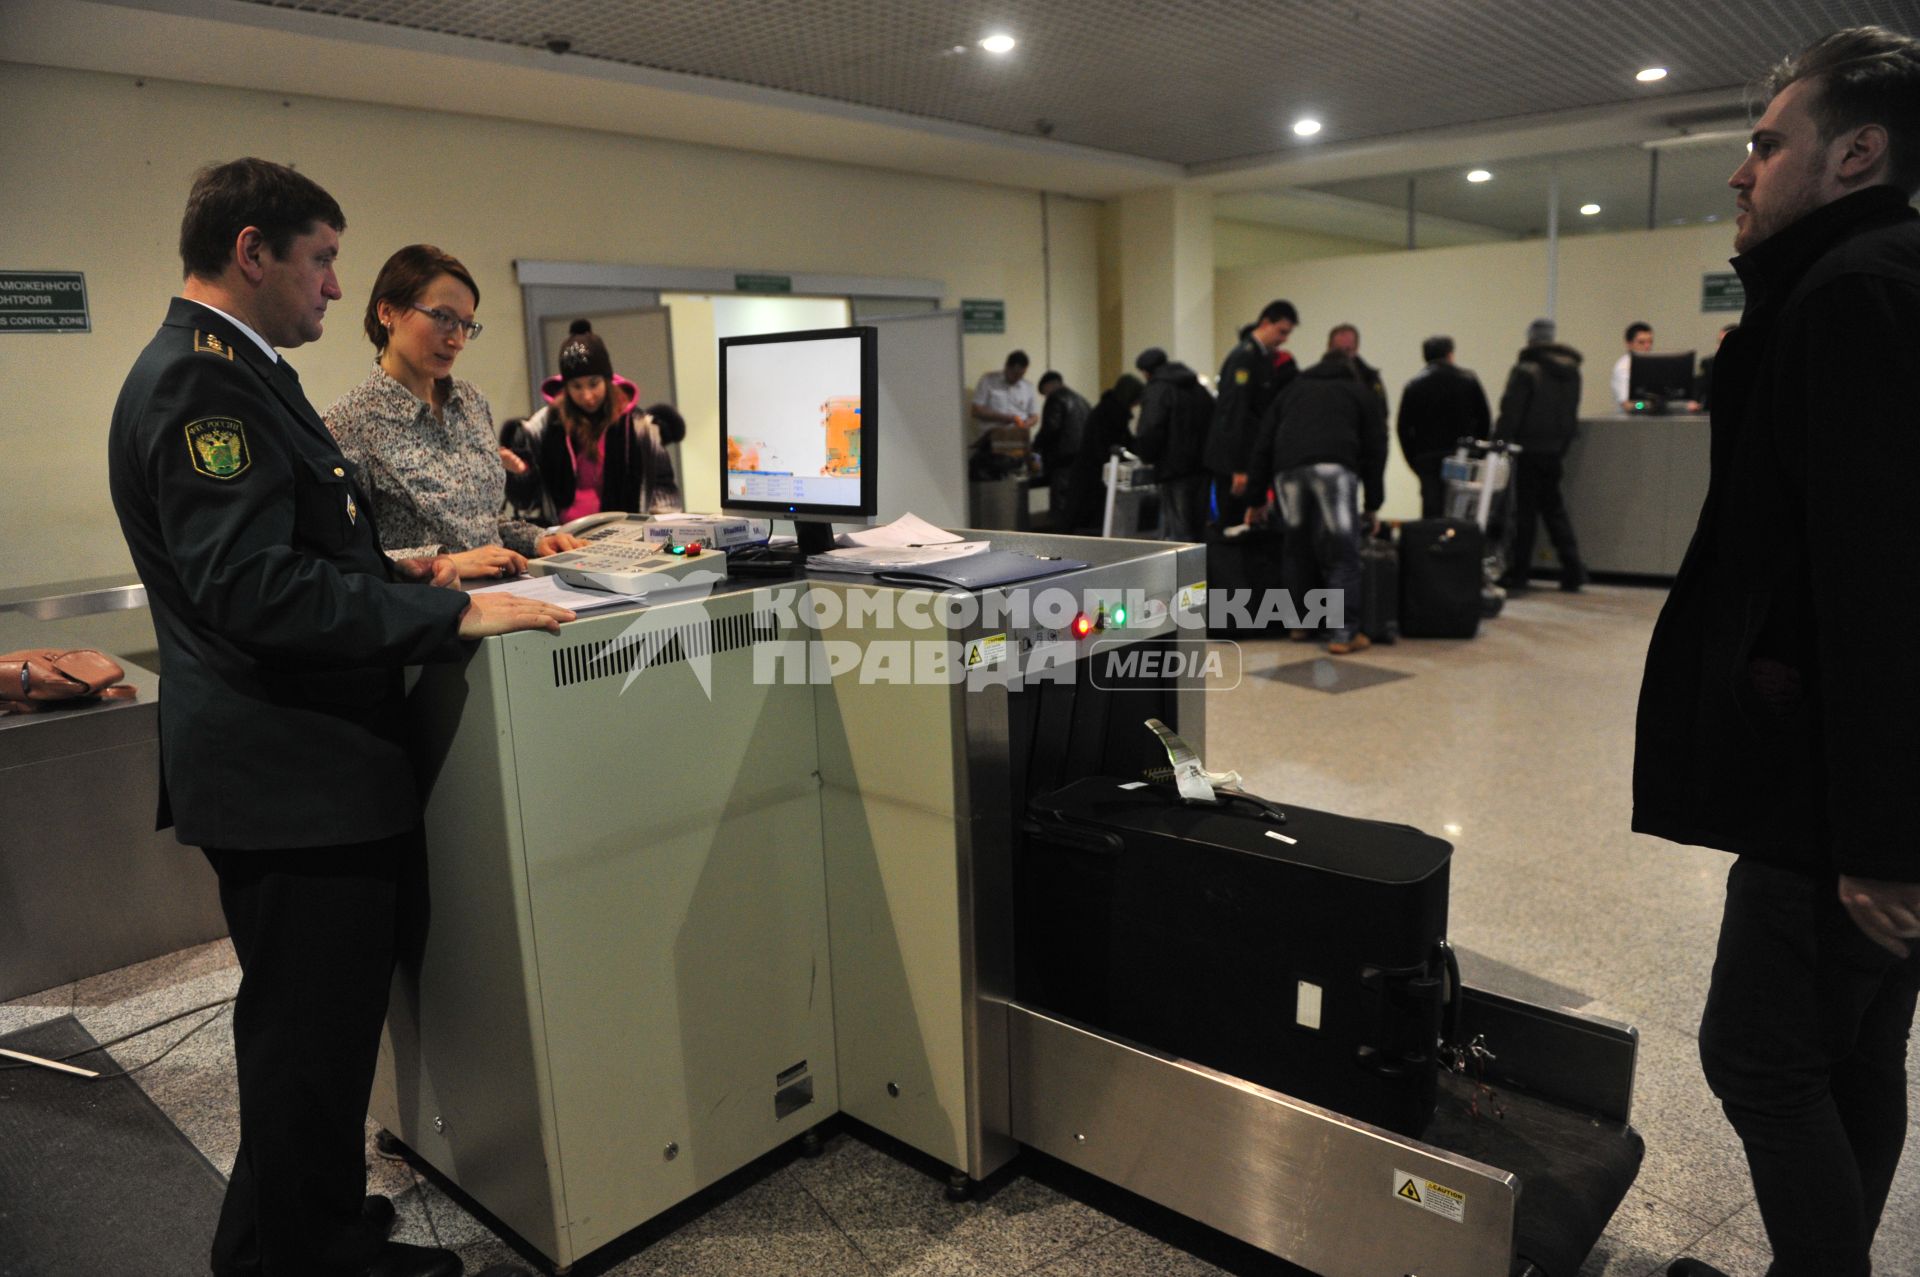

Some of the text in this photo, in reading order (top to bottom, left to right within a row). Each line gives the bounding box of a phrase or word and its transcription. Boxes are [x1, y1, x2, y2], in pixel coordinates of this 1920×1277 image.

[9, 316, 57, 326] CONTROL
[59, 316, 85, 326] ZONE
[1433, 1185, 1463, 1200] CAUTION
